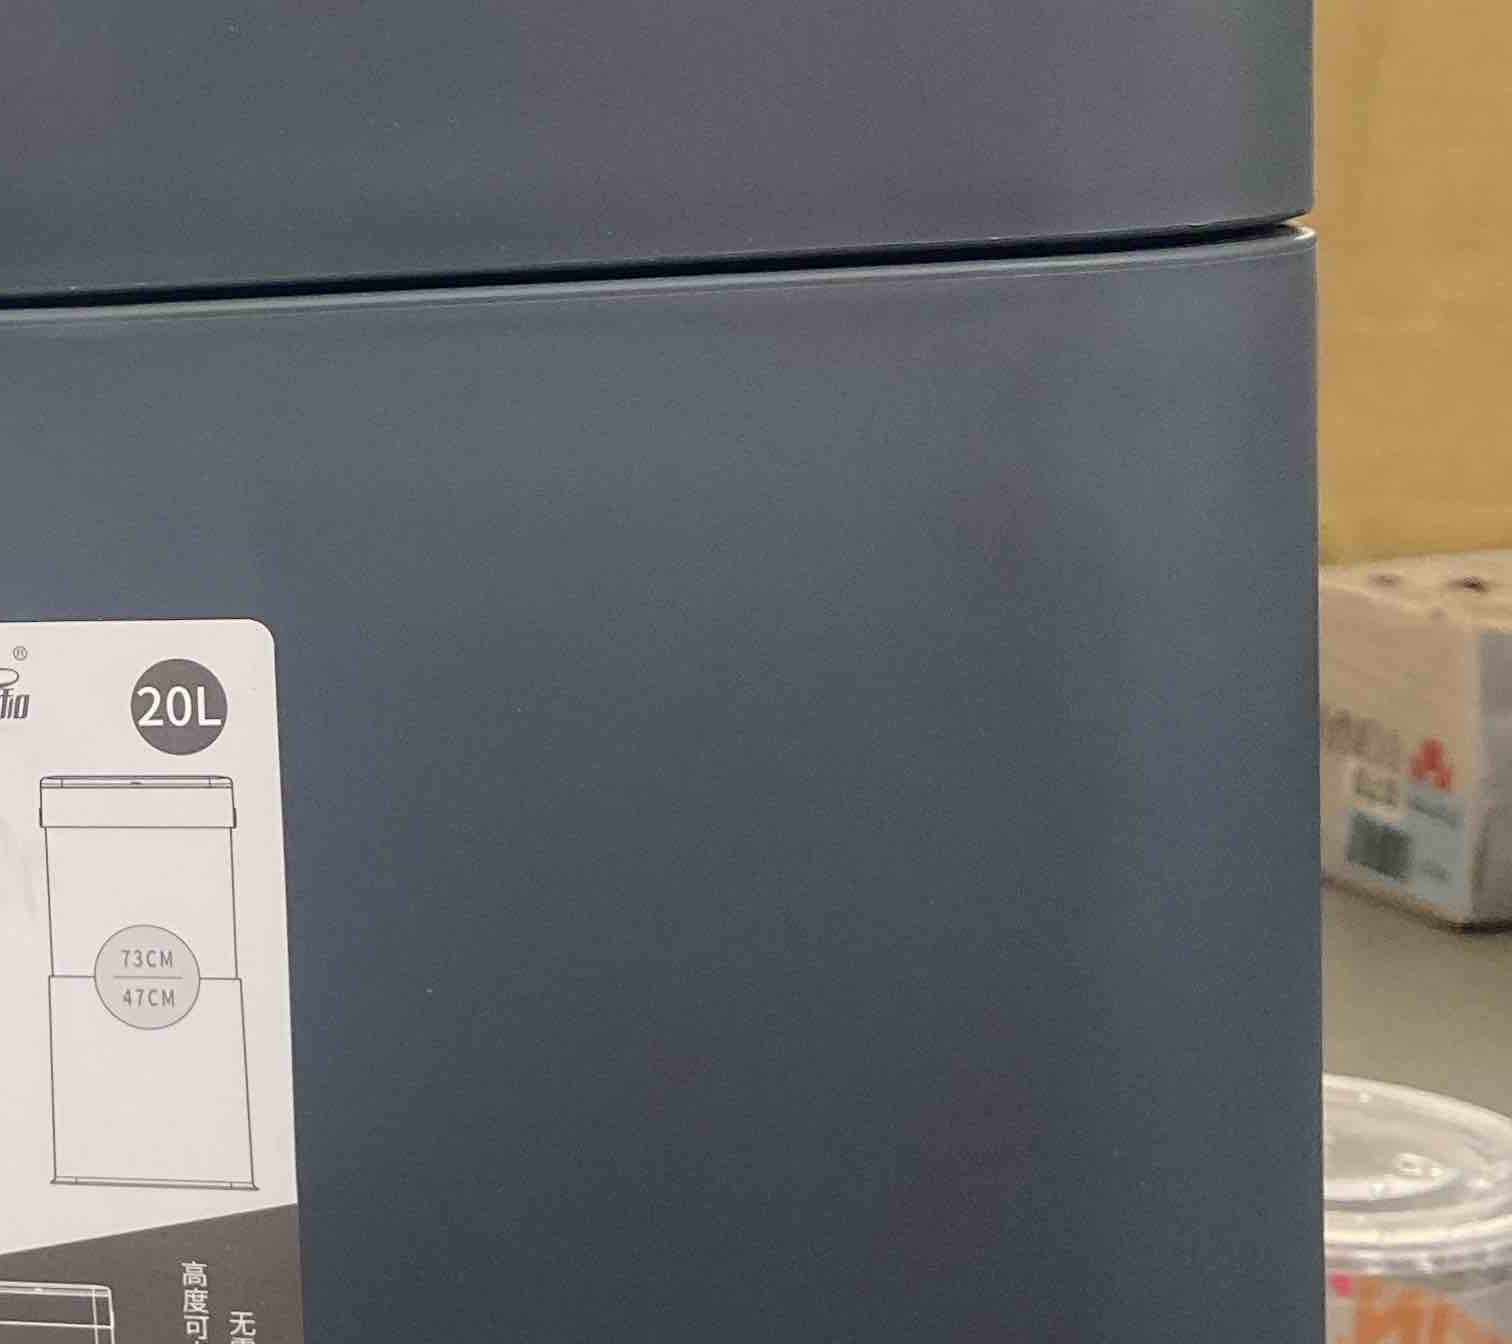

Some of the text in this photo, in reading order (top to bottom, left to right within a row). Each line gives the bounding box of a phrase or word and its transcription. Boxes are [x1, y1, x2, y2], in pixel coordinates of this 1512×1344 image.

[138, 684, 222, 728] 20L
[121, 948, 175, 969] 73CM
[121, 987, 176, 1008] 47CM
